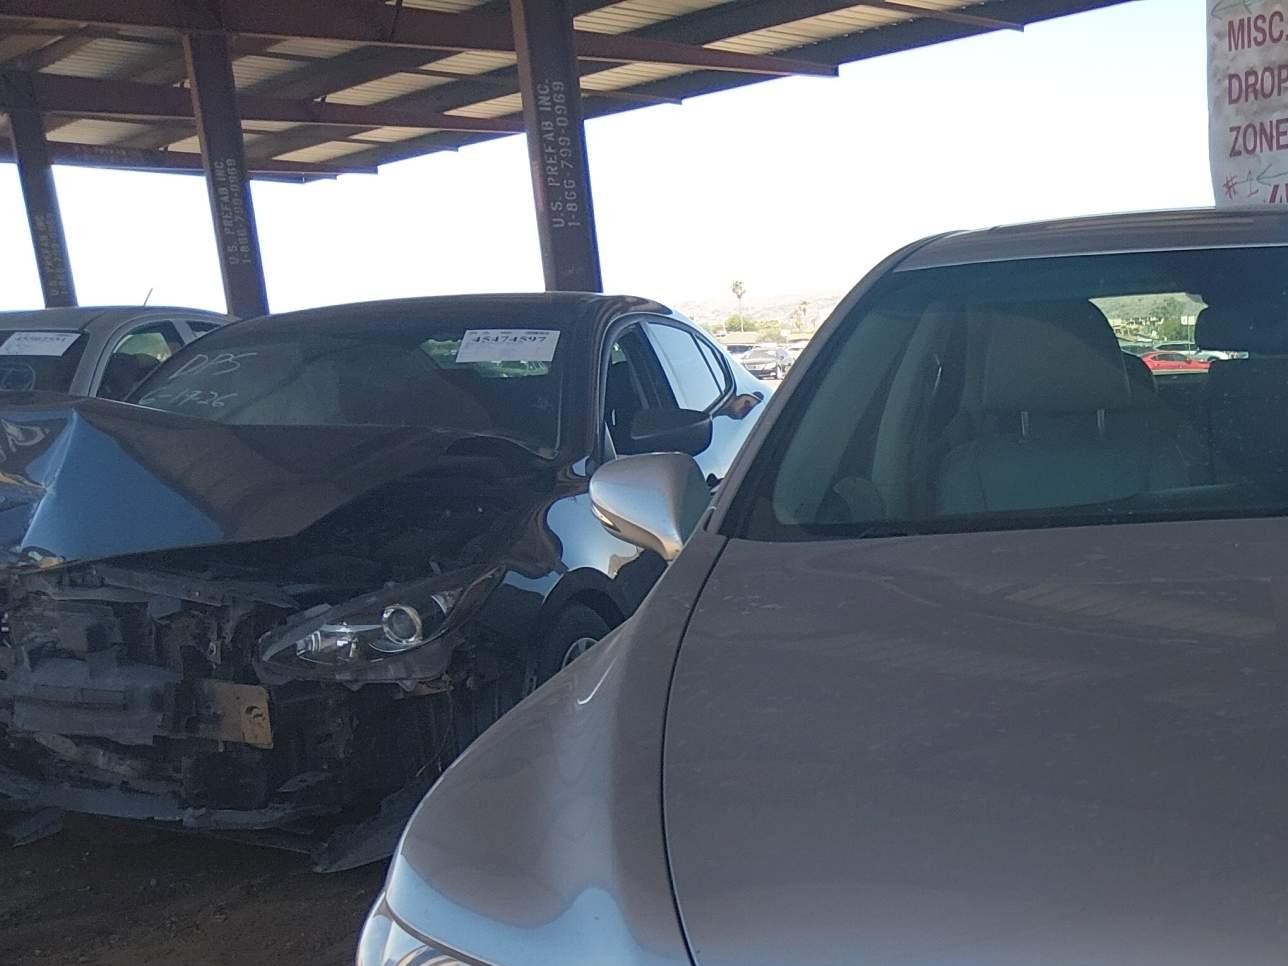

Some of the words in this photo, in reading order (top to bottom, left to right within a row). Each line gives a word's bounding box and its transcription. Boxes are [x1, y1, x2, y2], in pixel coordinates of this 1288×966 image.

[536, 79, 551, 111] INC.
[541, 120, 561, 187] PREFAB
[552, 195, 565, 228] U.S.
